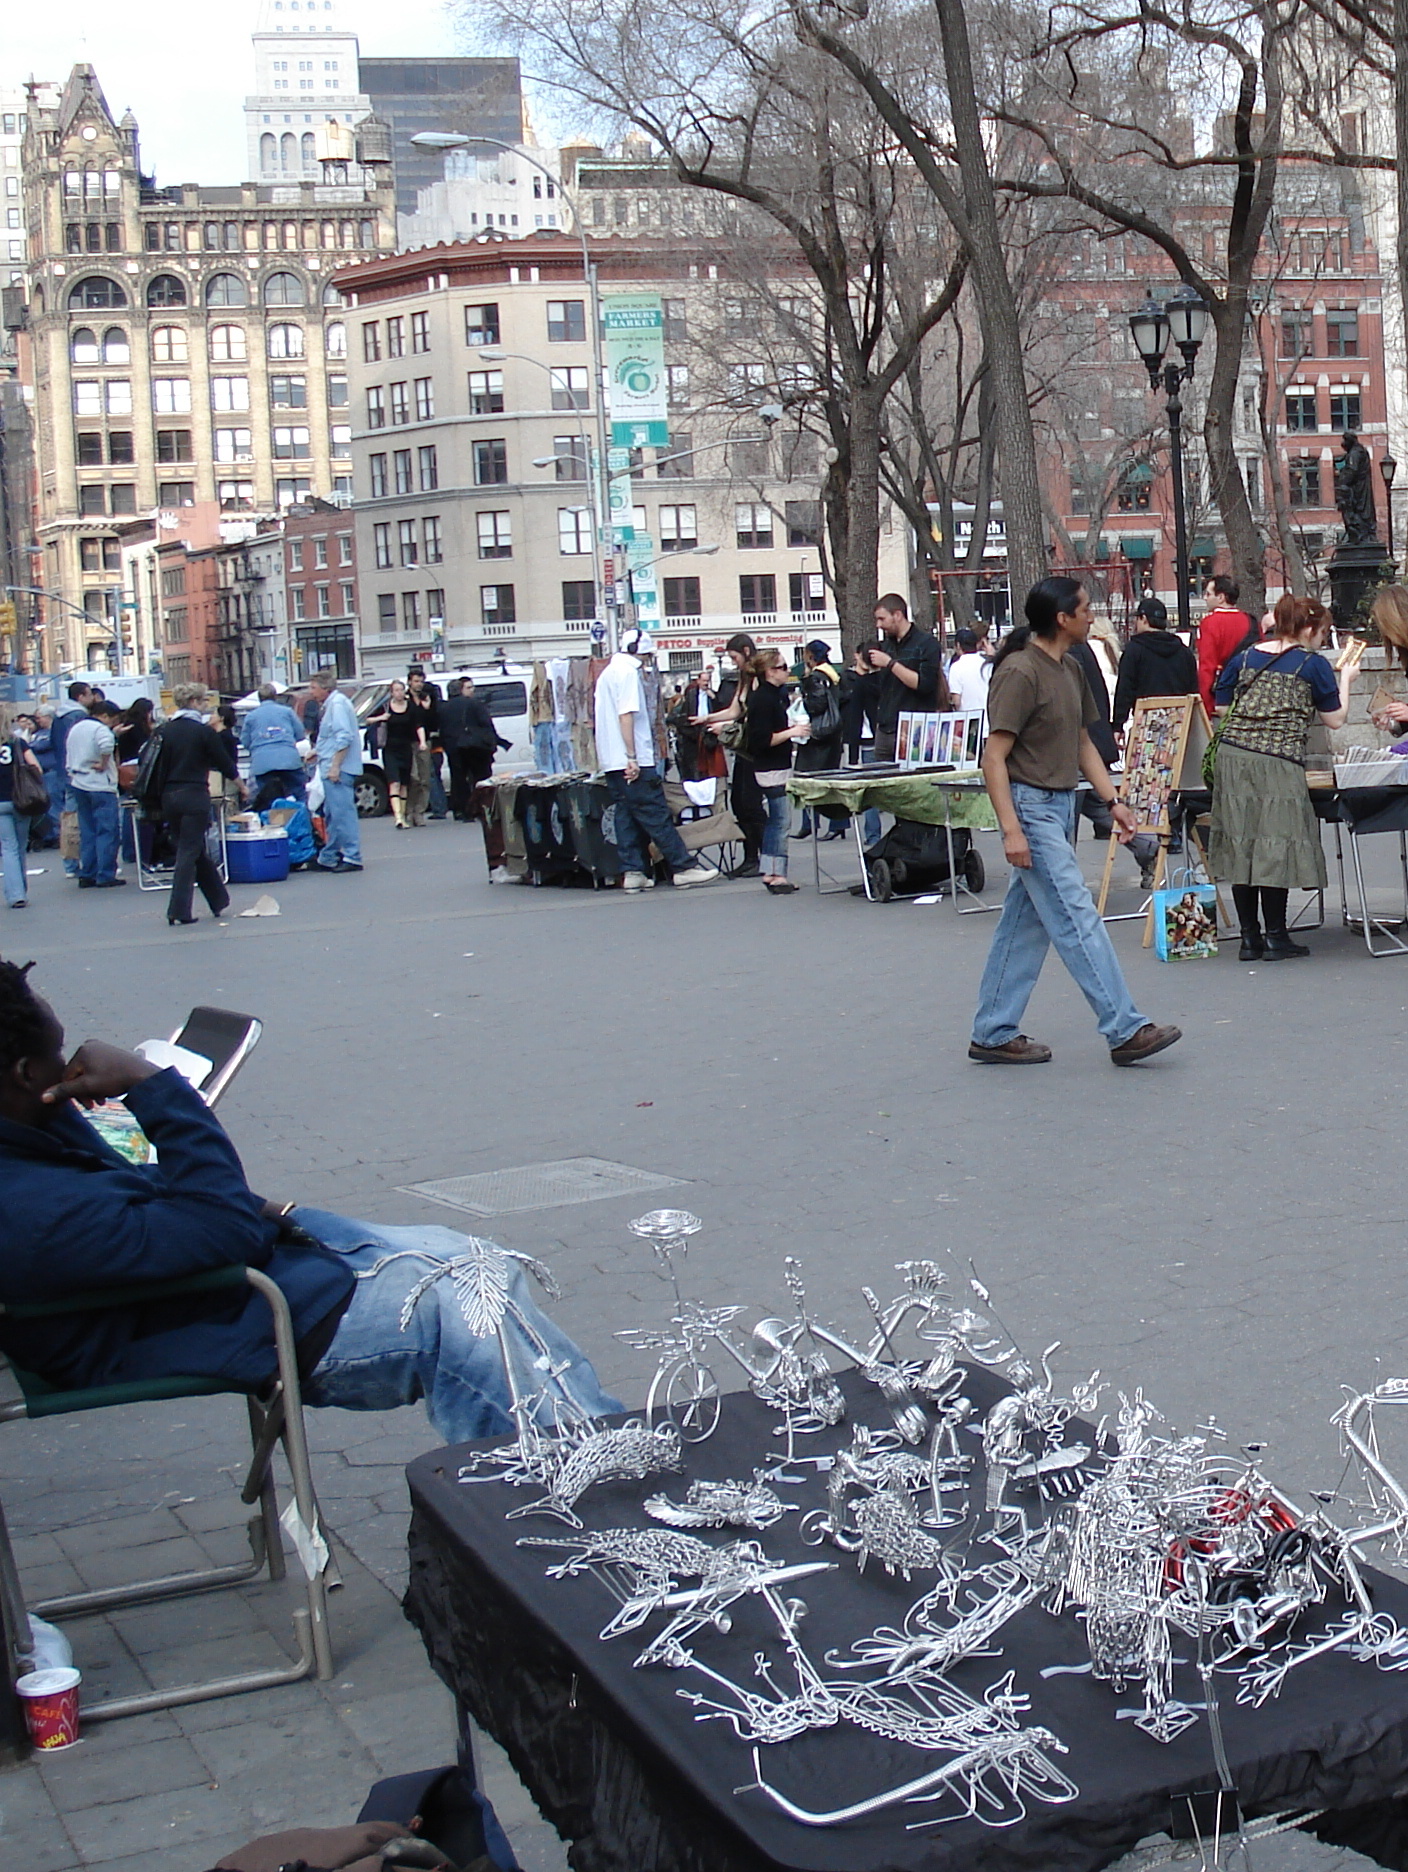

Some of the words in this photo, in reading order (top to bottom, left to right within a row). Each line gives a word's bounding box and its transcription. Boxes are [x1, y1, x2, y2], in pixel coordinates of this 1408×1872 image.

[608, 311, 656, 320] FARMERS
[608, 319, 655, 328] MARKET
[656, 638, 692, 649] PETCO
[766, 634, 803, 644] Grooming
